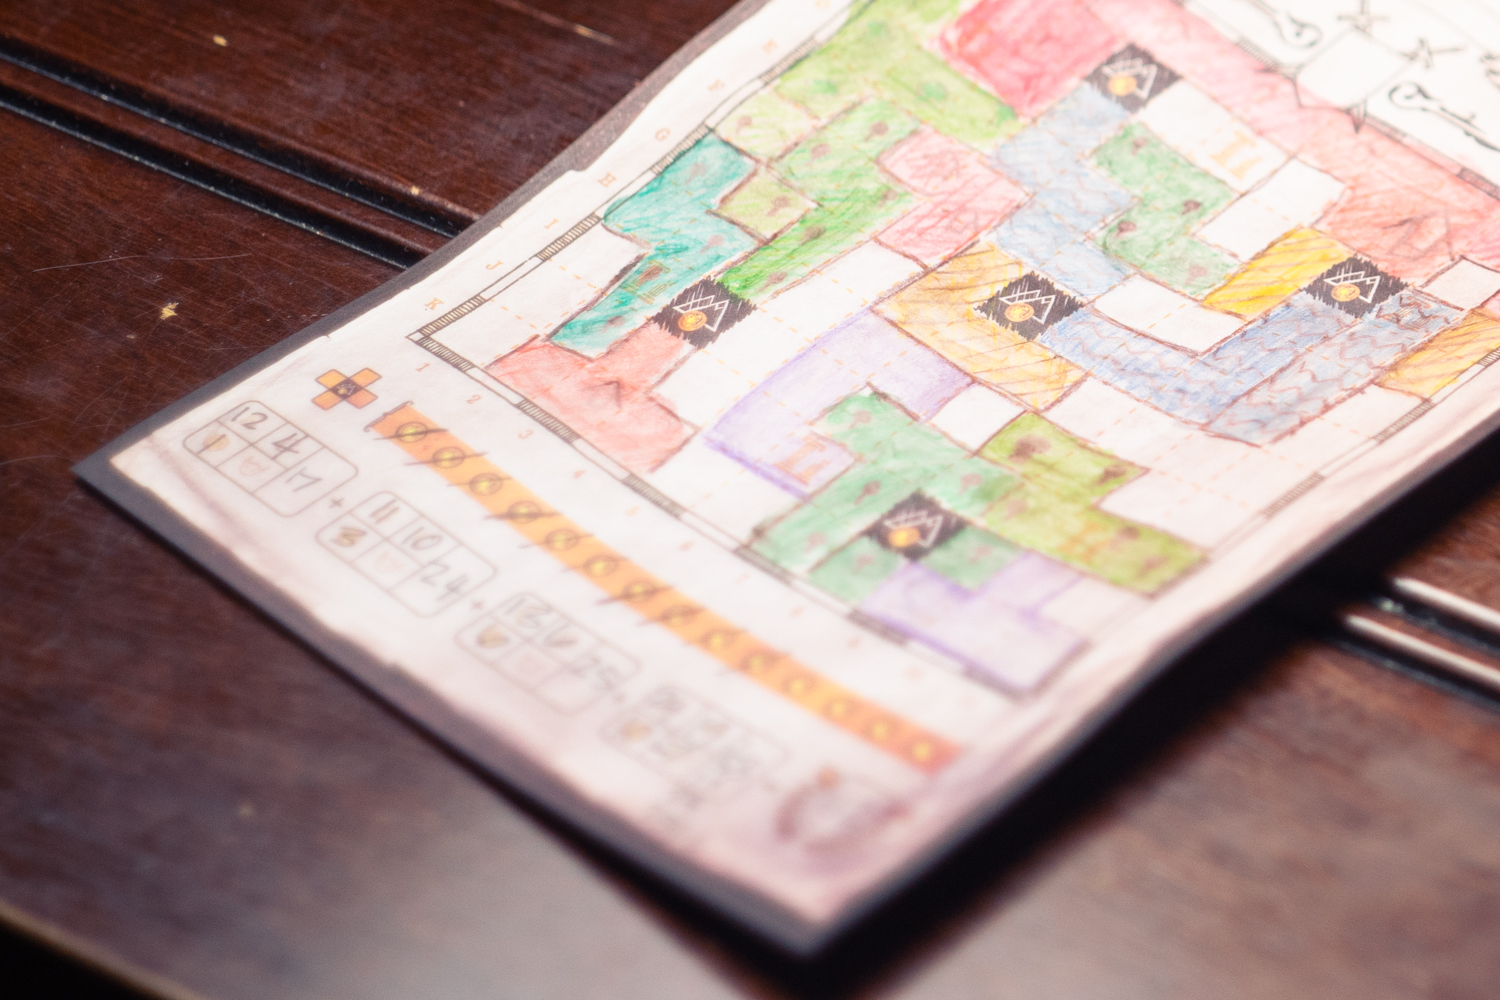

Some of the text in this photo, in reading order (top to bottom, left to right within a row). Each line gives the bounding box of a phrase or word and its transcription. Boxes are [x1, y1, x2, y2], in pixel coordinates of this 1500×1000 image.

[465, 393, 482, 406] 2
[231, 406, 268, 431] 12
[271, 432, 310, 461] 4
[284, 466, 324, 493] 17
[400, 526, 443, 551] 10
